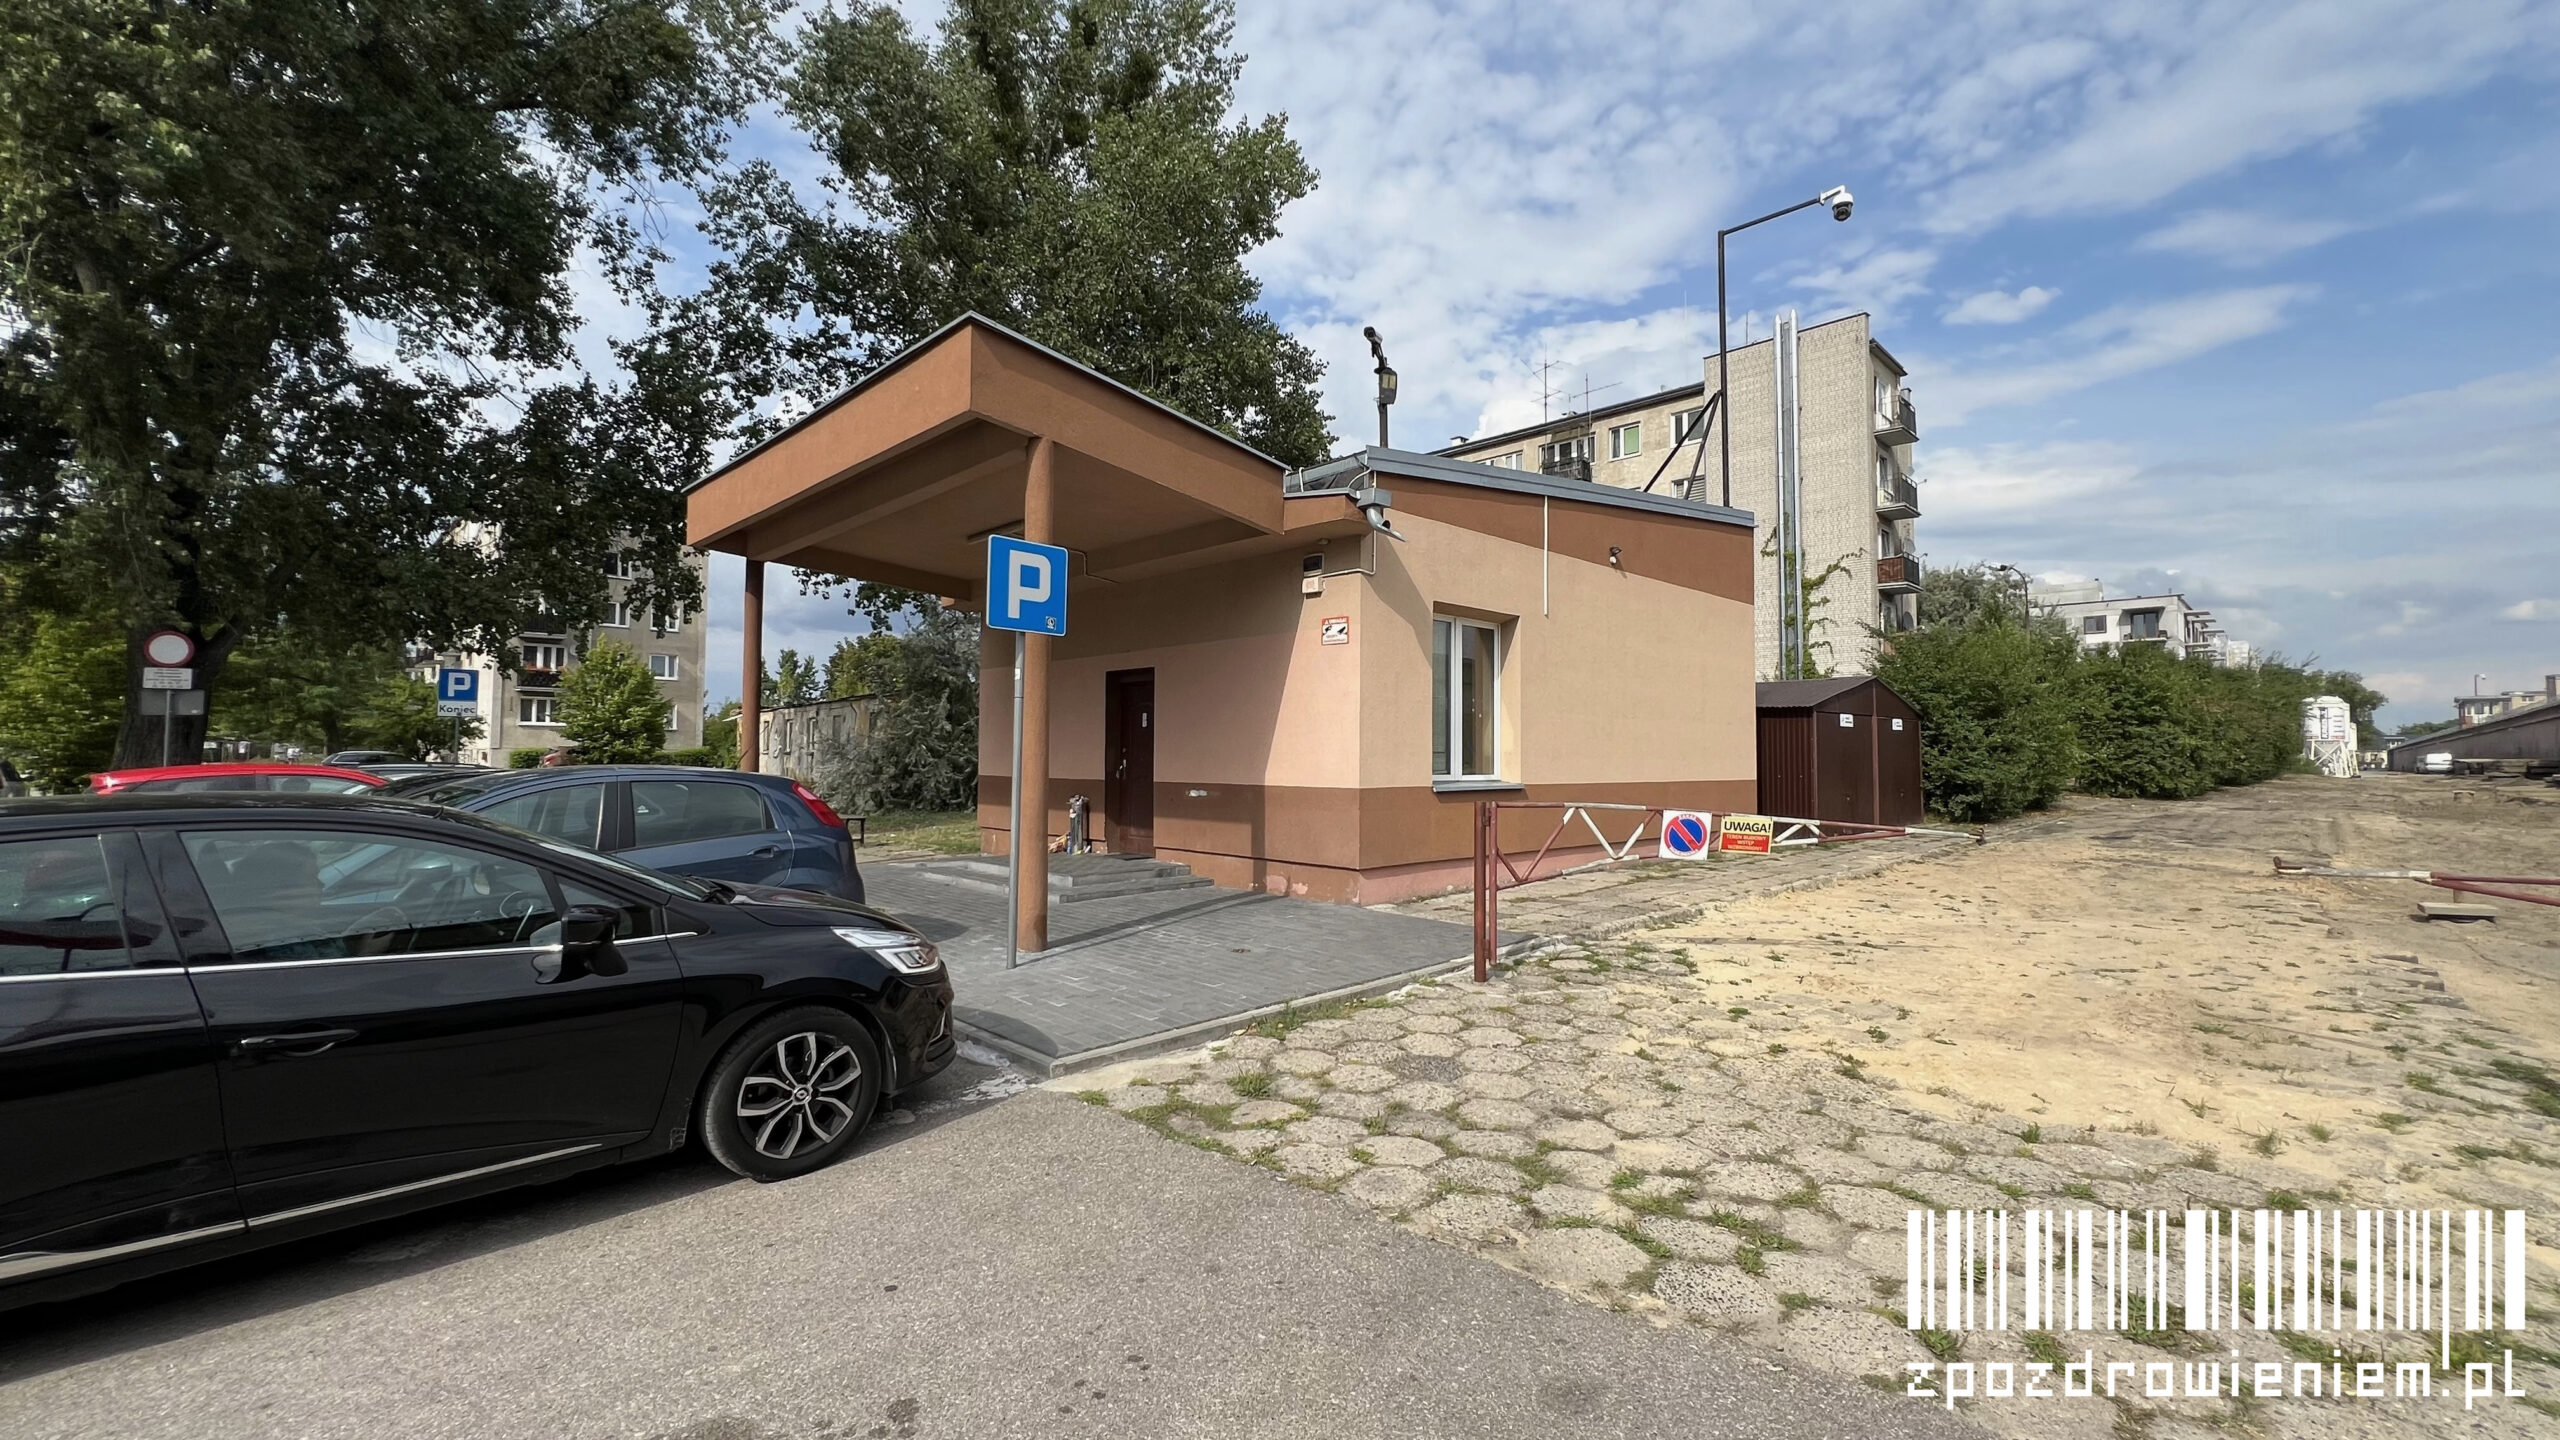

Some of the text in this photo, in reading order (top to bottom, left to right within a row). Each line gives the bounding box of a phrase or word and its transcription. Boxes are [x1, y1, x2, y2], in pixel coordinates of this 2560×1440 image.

[1008, 550, 1051, 619] P
[448, 672, 471, 697] P
[439, 705, 476, 714] Koniec
[1724, 821, 1771, 833] UWAGA!
